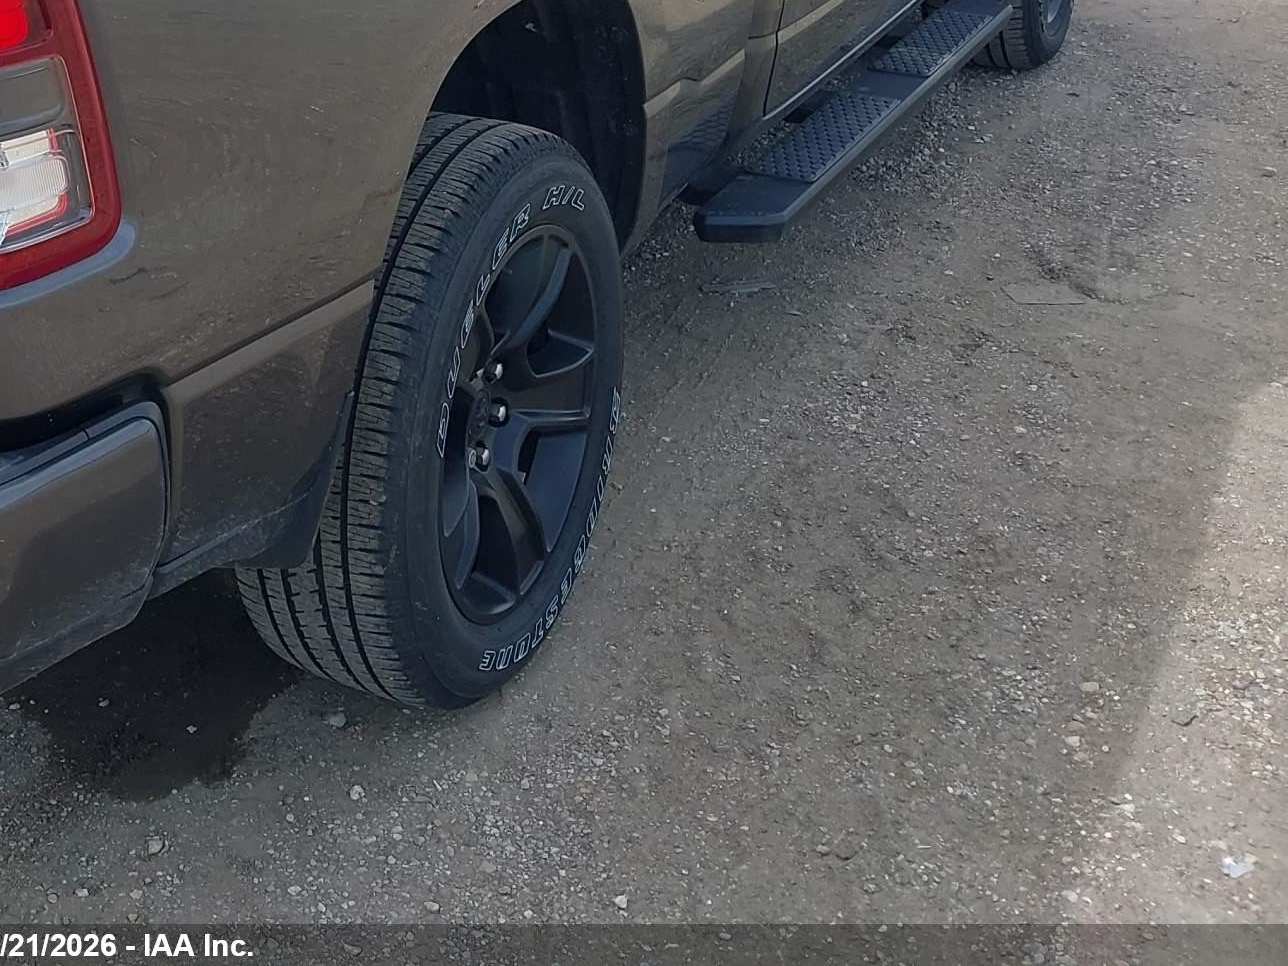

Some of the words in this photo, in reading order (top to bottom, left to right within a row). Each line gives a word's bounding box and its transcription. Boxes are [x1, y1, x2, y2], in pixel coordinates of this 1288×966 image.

[436, 202, 531, 459] DUELER
[542, 184, 586, 211] H/L
[479, 385, 621, 671] BRIDGESTONE
